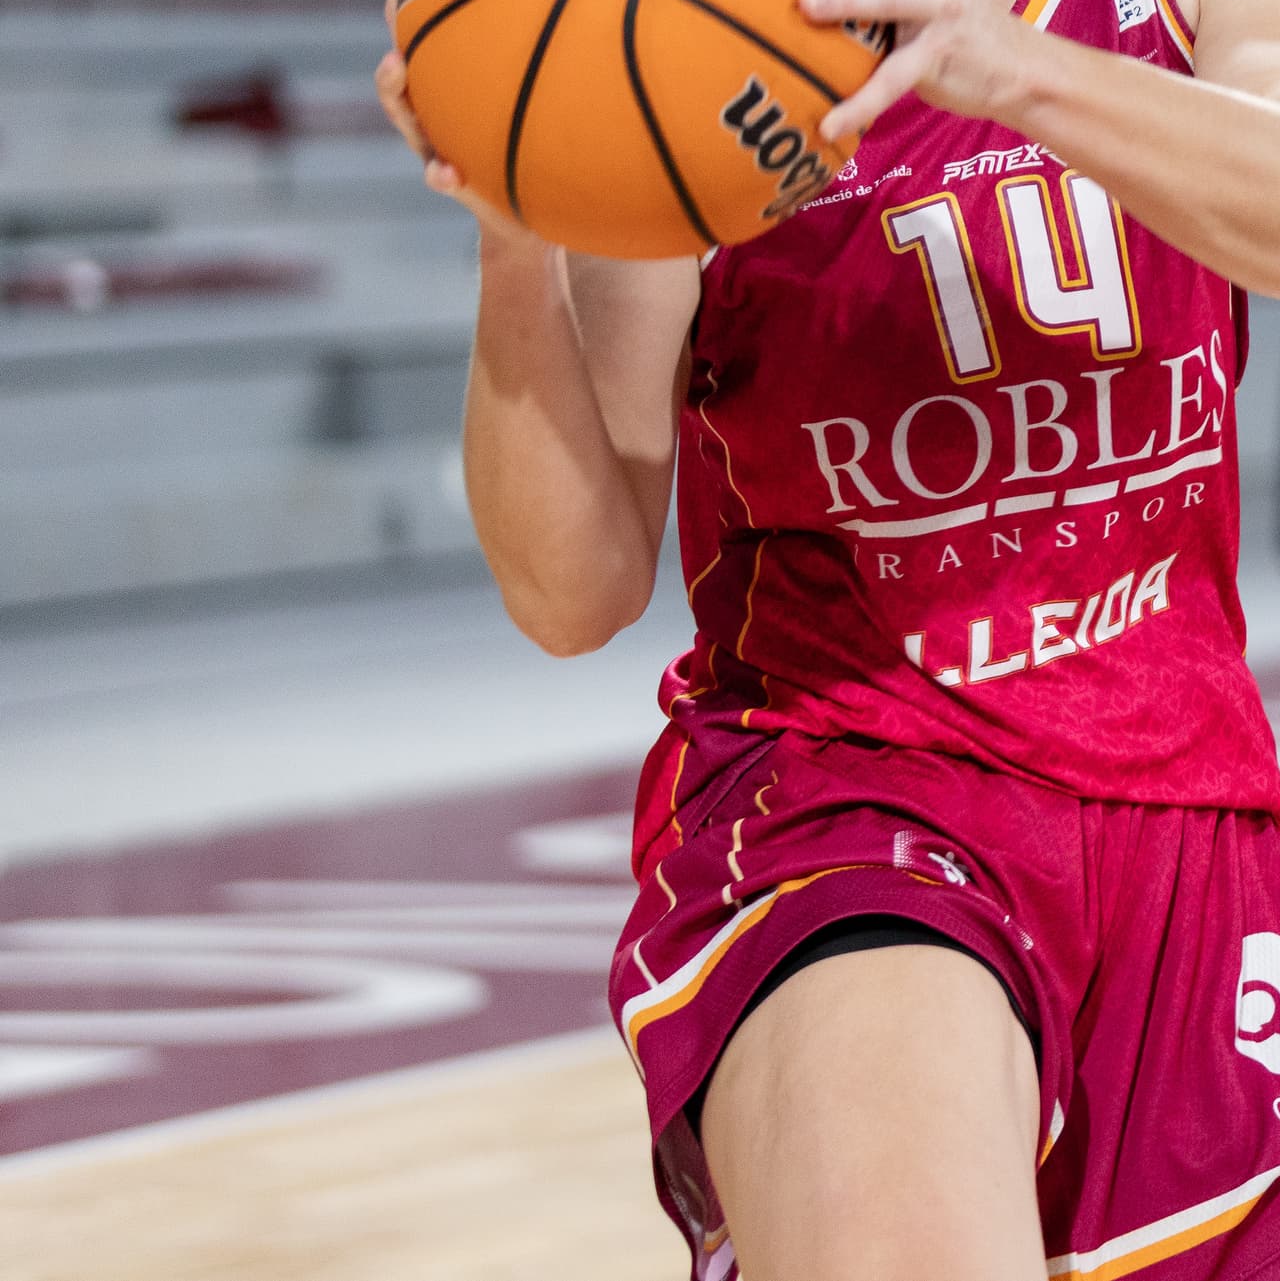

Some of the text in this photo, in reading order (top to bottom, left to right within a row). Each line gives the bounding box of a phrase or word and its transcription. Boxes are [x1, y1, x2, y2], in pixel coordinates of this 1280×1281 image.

[799, 188, 854, 211] putació
[855, 185, 873, 198] de
[881, 174, 1141, 384] 14
[801, 329, 1228, 514] ROBLES
[876, 481, 1206, 580] RANSPOR
